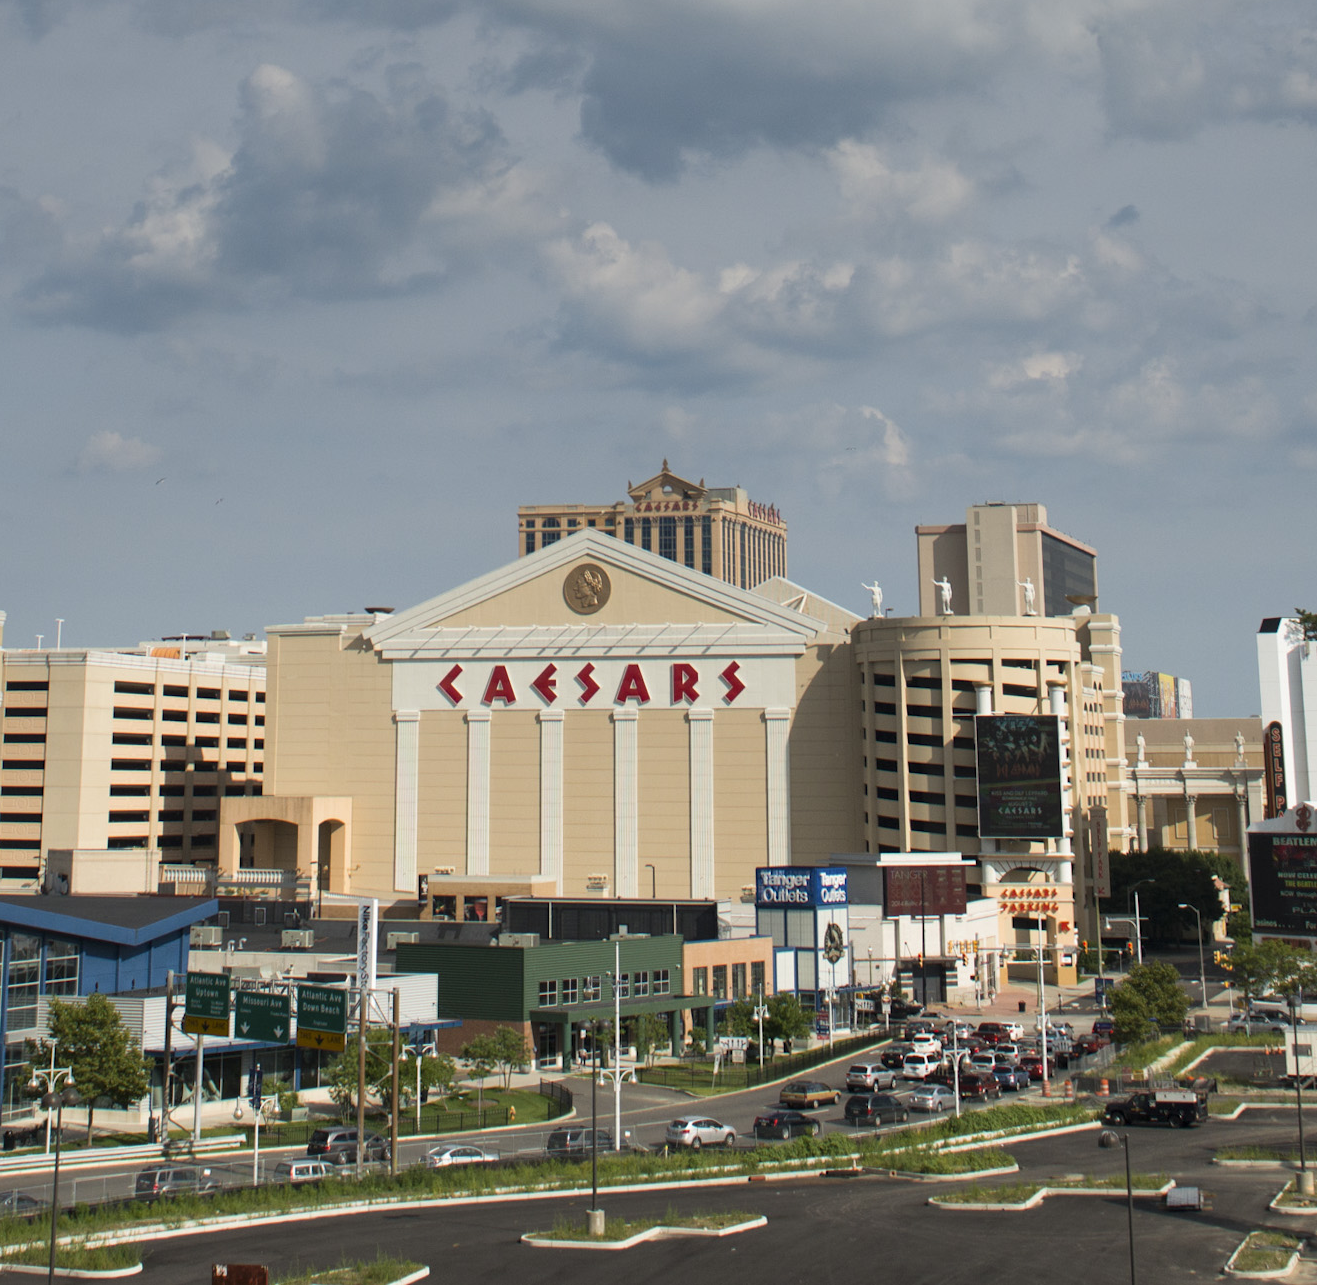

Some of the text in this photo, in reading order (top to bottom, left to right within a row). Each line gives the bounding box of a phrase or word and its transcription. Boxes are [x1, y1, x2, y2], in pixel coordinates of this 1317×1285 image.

[635, 501, 698, 512] CAESARS
[437, 661, 746, 707] CAESARS
[1271, 728, 1284, 787] SELF
[998, 807, 1042, 815] CAESARS
[761, 870, 810, 889] Tanger
[820, 872, 847, 889] Tanger
[763, 887, 809, 903] Outlets
[821, 887, 847, 903] Outlets
[1000, 888, 1058, 900] CAESARS
[1000, 901, 1059, 914] PARKING
[1305, 921, 1316, 930] For
[190, 975, 226, 987] Atlantic Ave
[196, 987, 219, 998] Uptown
[302, 990, 342, 1003] Atlantic Ave
[242, 996, 282, 1008] Missouri Ave
[302, 1002, 340, 1014] Down Beach
